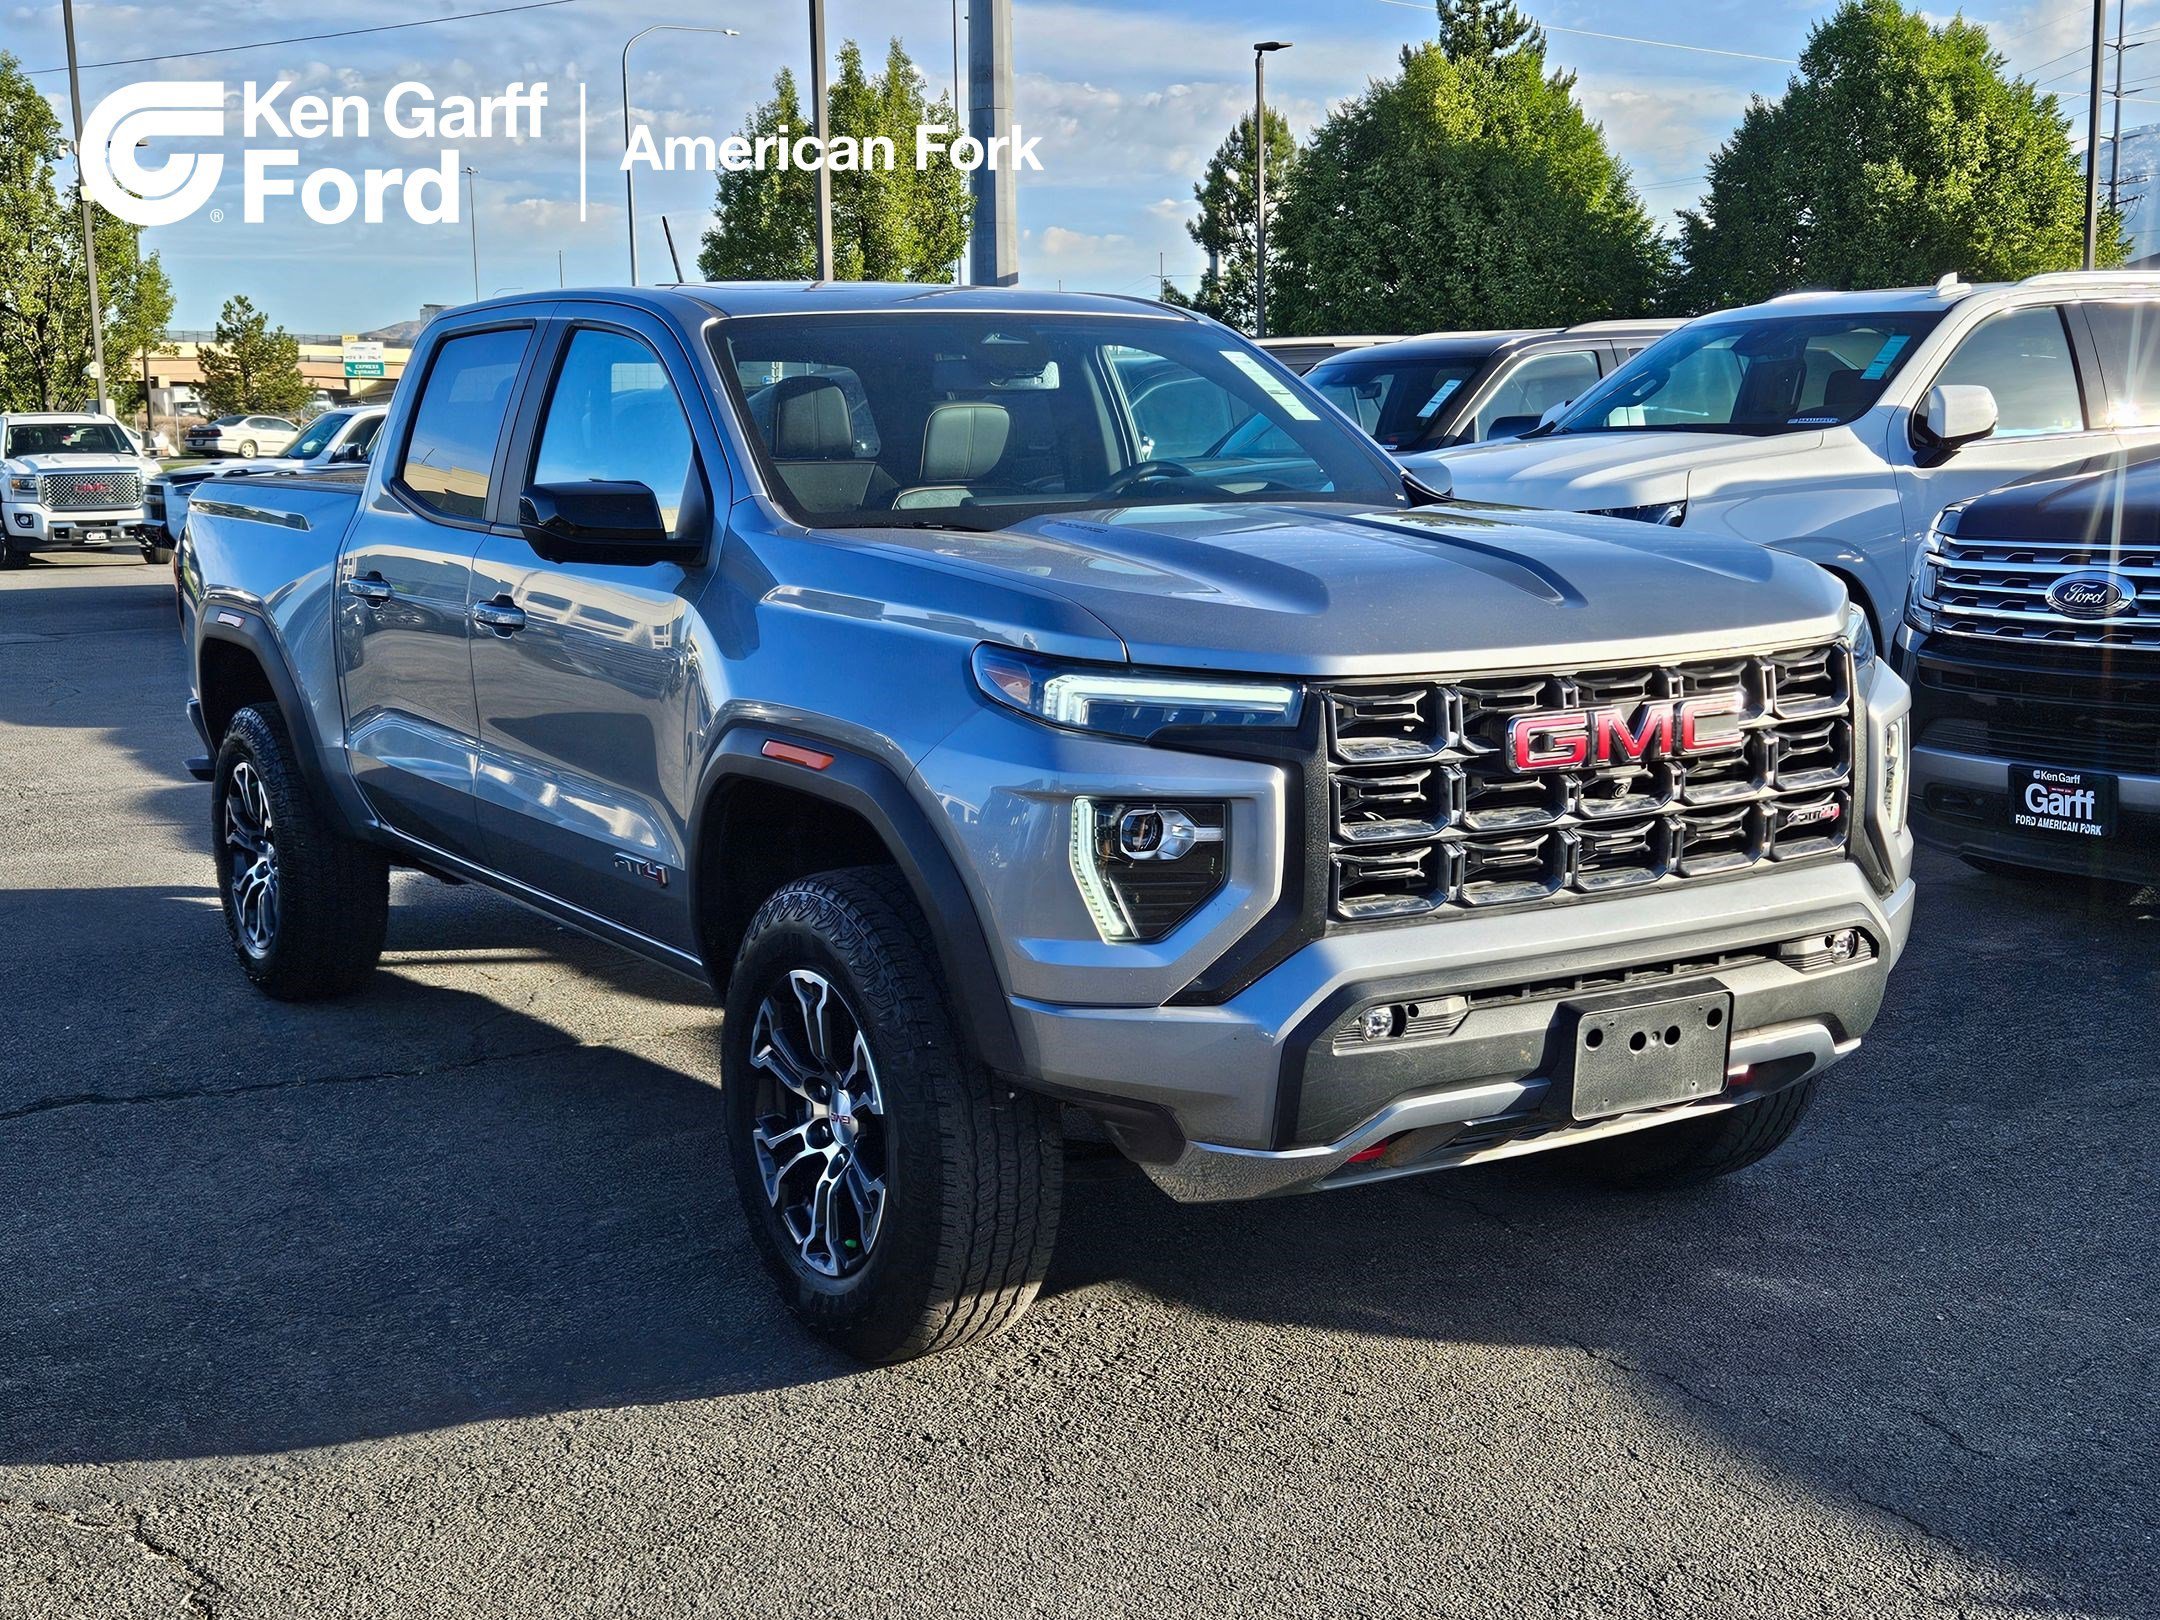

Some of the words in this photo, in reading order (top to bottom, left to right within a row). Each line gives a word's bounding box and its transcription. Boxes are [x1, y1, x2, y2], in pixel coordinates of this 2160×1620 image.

[2064, 582, 2107, 604] Ford
[1506, 692, 1745, 775] GMC
[2040, 770, 2058, 781] Ken
[2058, 773, 2081, 785] Garff
[2025, 783, 2096, 820] Garff
[2015, 814, 2036, 827] FORD
[2037, 817, 2079, 833] AMERICAN
